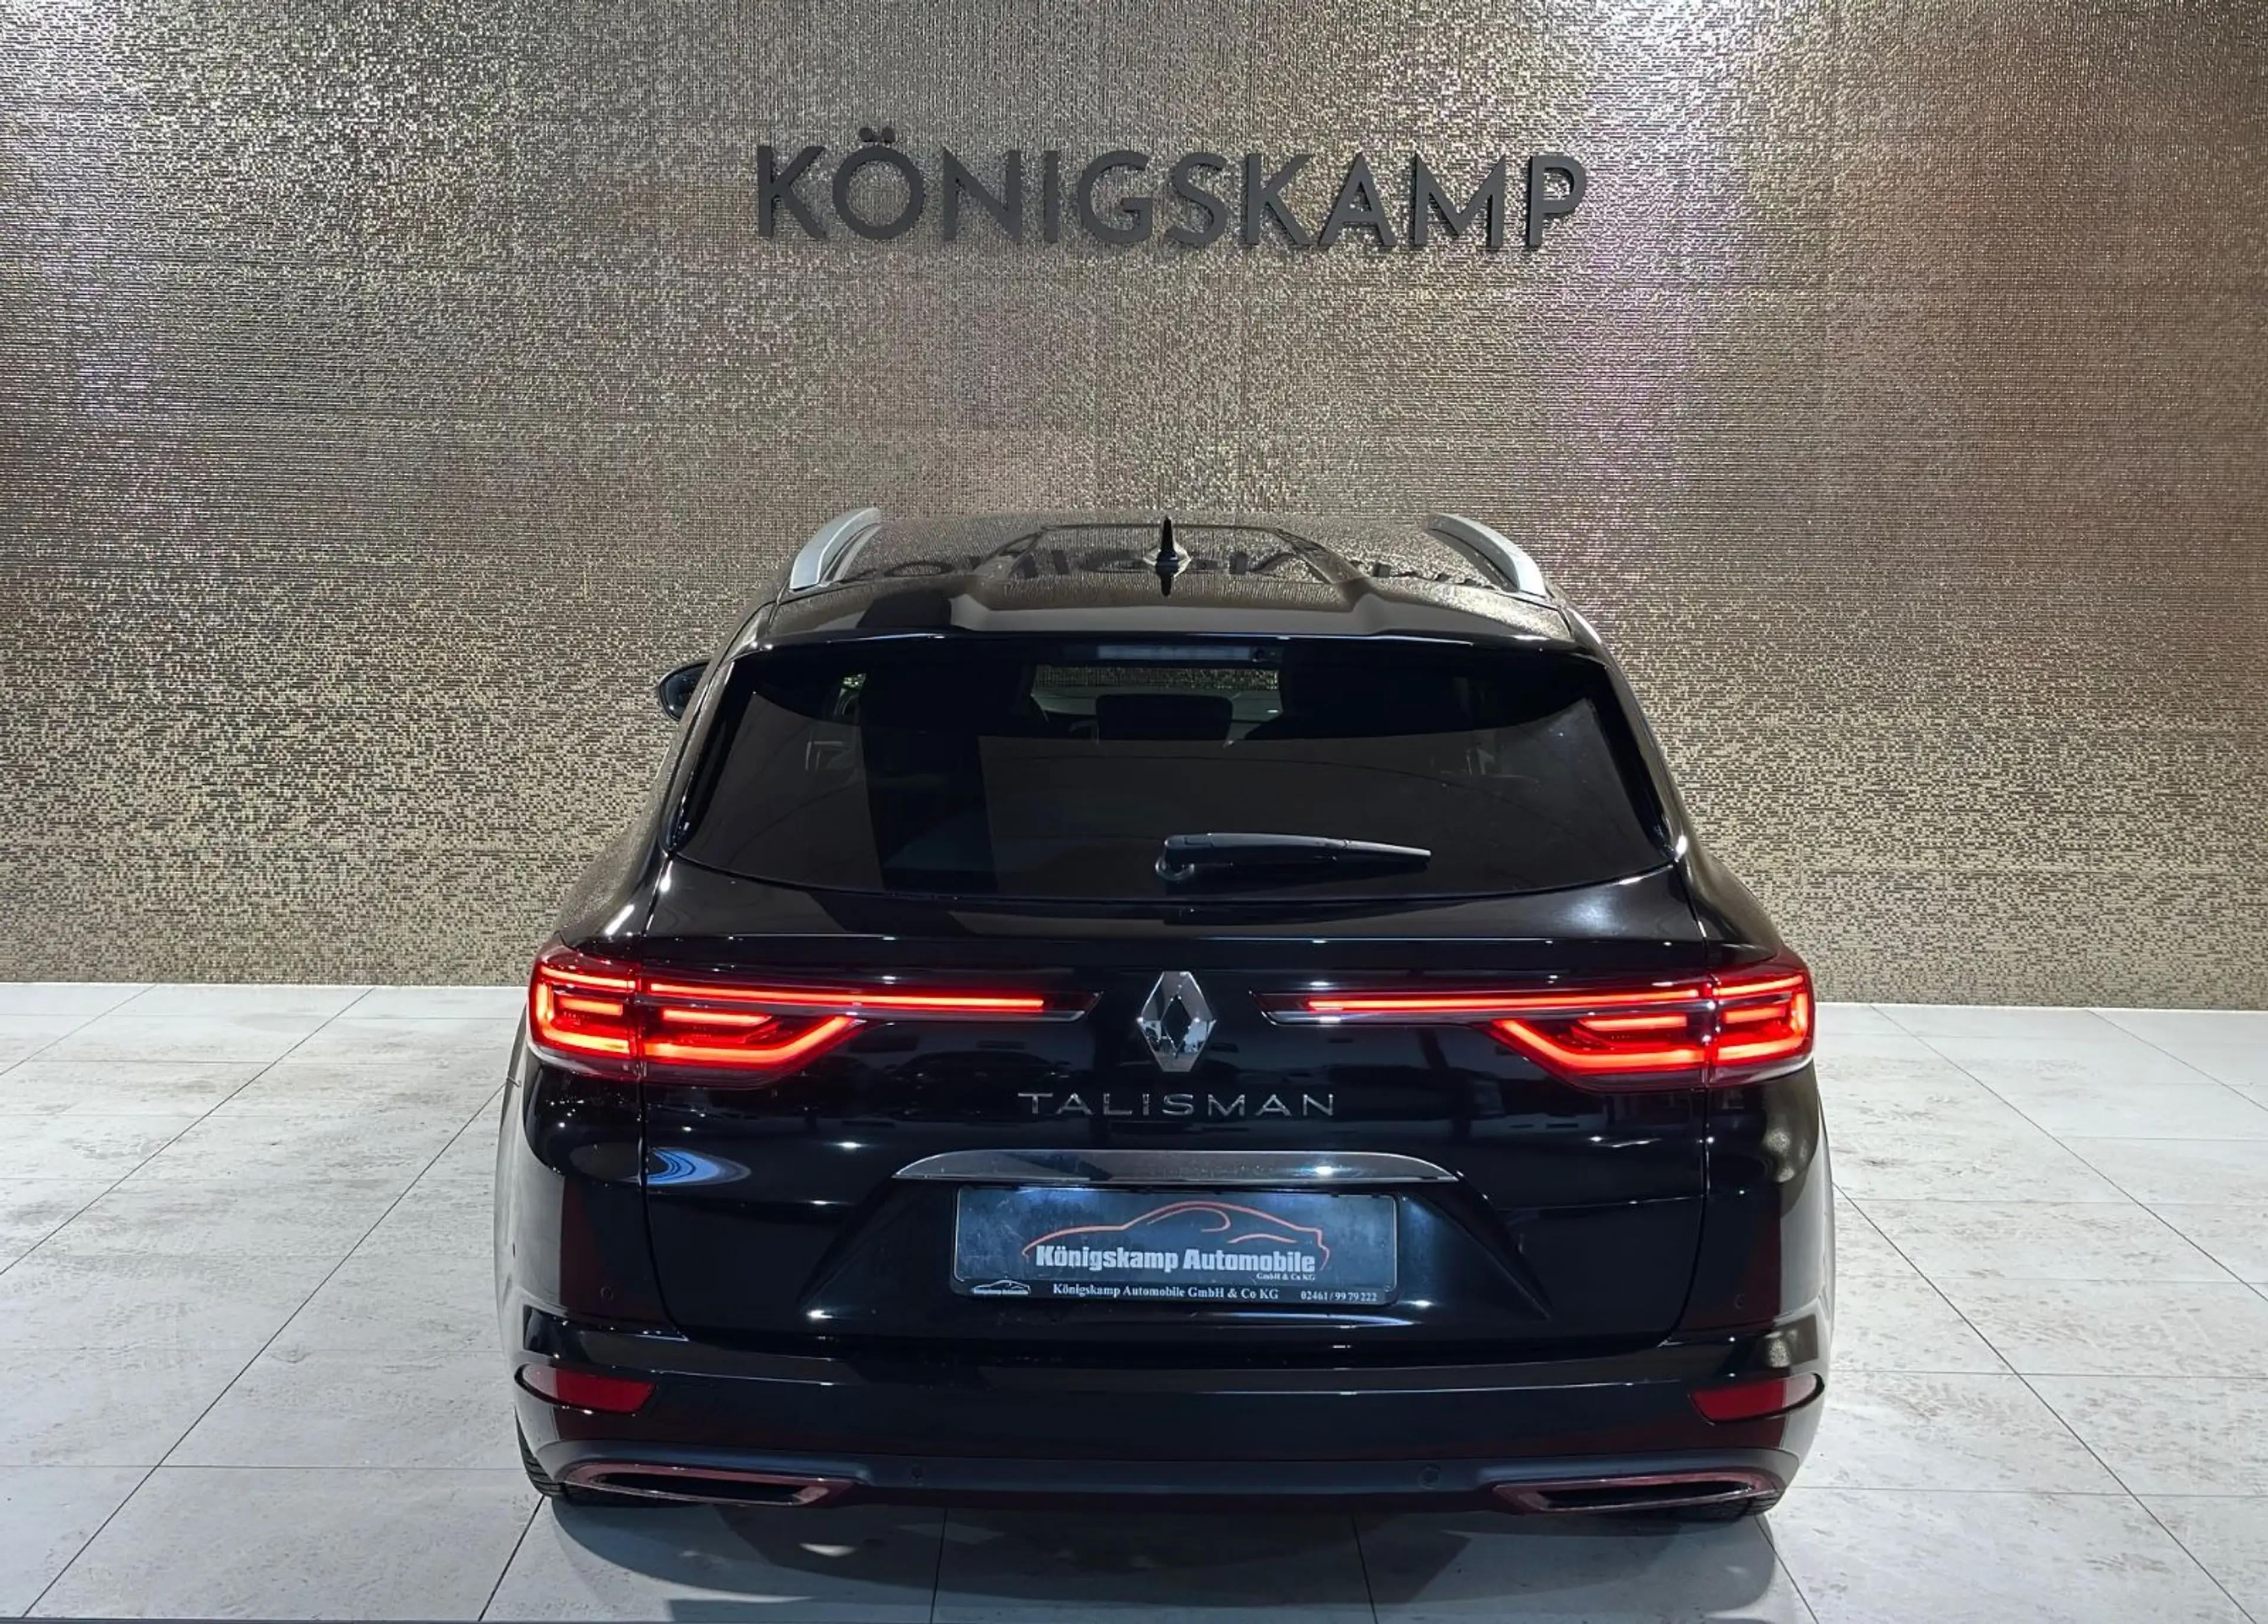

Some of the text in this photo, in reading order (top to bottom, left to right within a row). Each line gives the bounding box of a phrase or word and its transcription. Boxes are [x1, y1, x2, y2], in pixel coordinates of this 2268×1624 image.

[757, 127, 1587, 249] KÖNIGSKAMP
[1017, 1093, 1334, 1117] TALISMAN
[1035, 1245, 1316, 1273] Königskamp Automobile
[1052, 1283, 1279, 1300] Königskamp Automobile GmbH & Co KG
